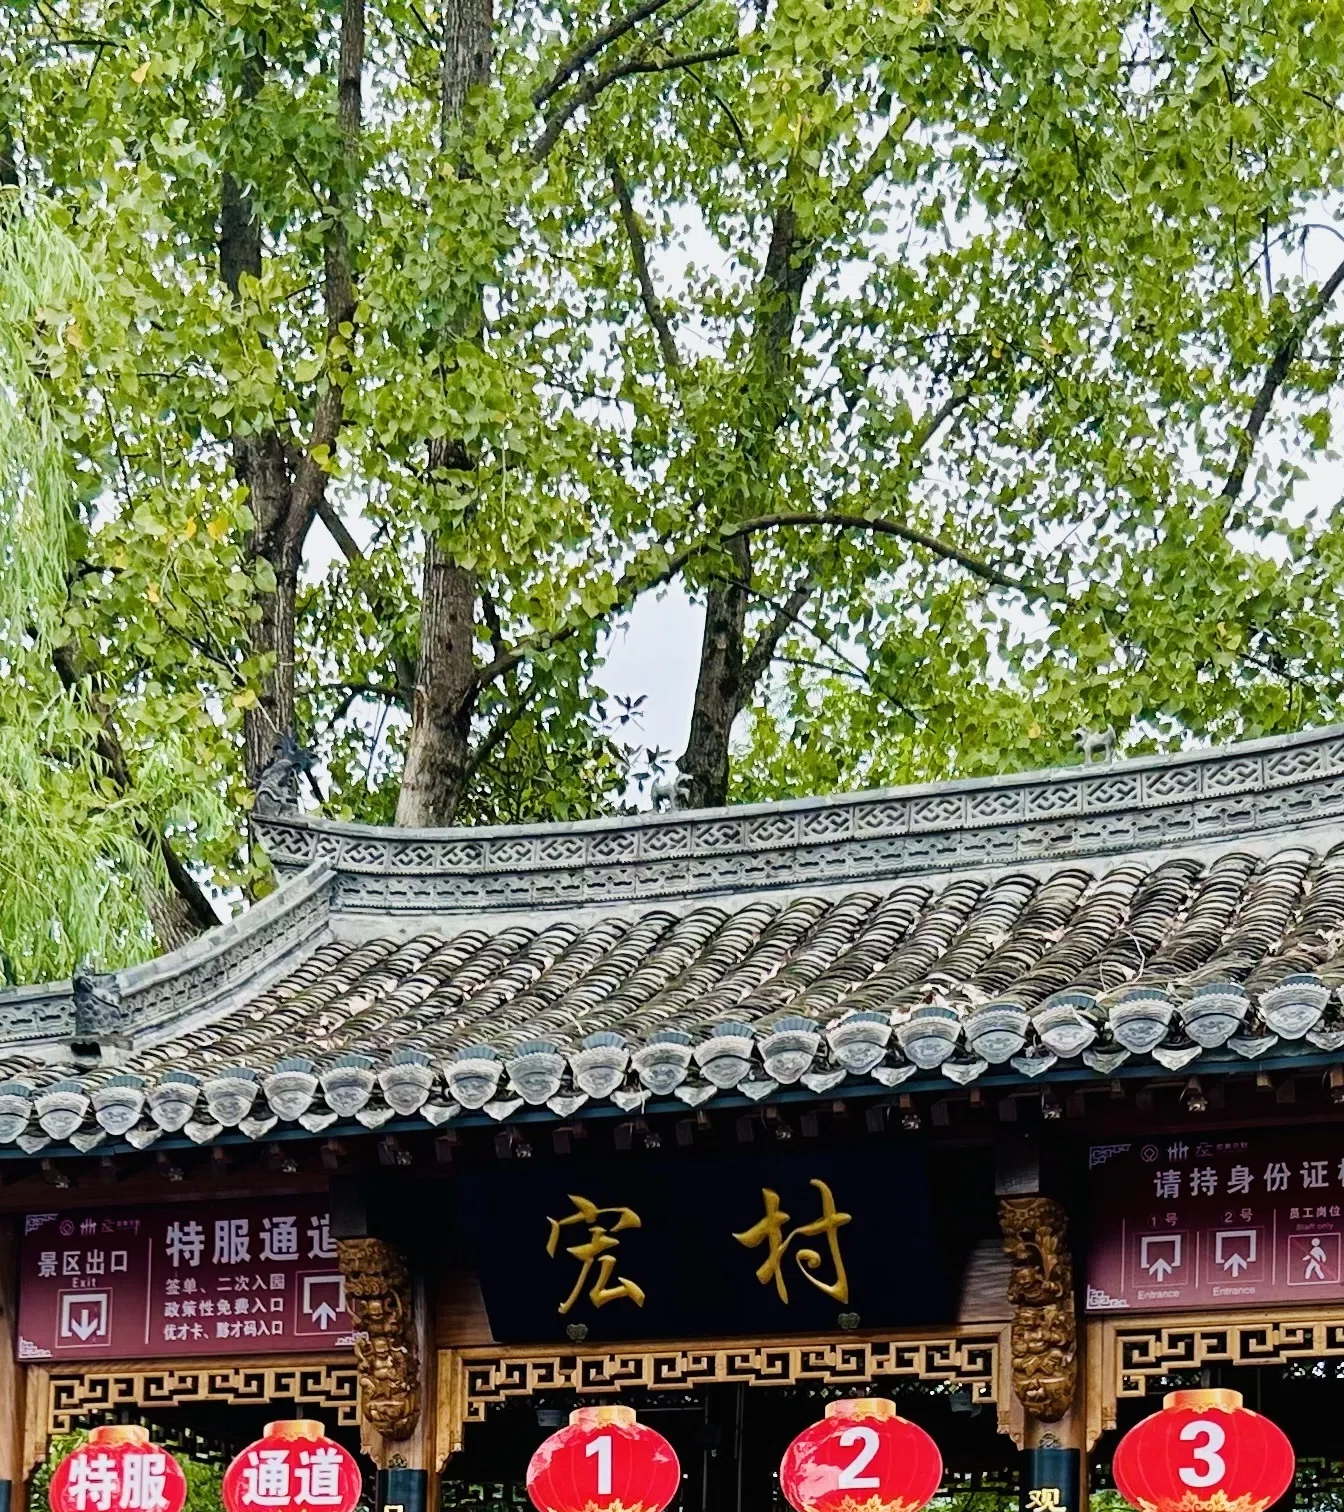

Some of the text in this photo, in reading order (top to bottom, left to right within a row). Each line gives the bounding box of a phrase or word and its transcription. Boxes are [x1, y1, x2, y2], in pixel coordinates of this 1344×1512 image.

[1289, 1206, 1341, 1219] 员工岗位
[38, 1250, 128, 1277] 景区出口
[546, 1179, 852, 1314] 宏村
[72, 1278, 97, 1288] Exit
[1138, 1290, 1180, 1299] Entrance
[1213, 1287, 1255, 1296] Entrance
[164, 1298, 283, 1317] 政策性免费入口
[585, 1436, 613, 1494] 1
[837, 1427, 881, 1489] 2
[1178, 1421, 1226, 1486] 3
[69, 1453, 168, 1510] 特服
[243, 1447, 343, 1506] 通道
